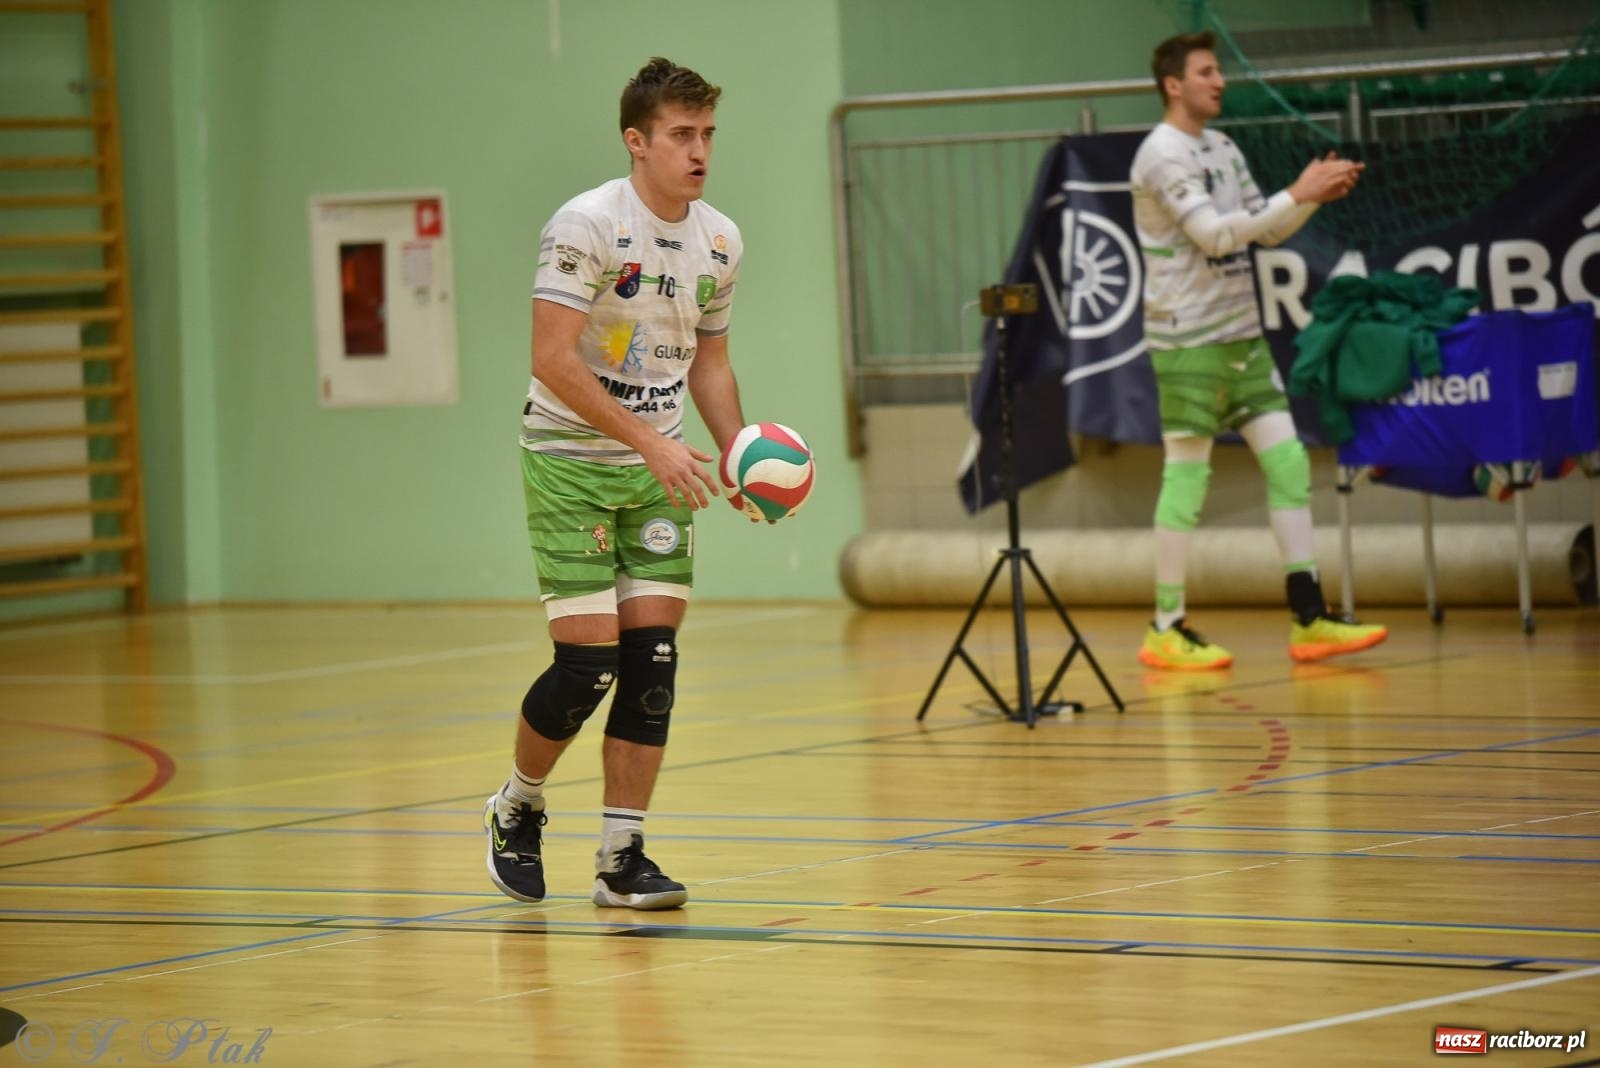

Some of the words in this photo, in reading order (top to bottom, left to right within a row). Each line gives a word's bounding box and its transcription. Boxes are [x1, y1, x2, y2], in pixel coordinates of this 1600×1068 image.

[657, 274, 675, 298] 10
[592, 372, 645, 400] OMPY
[1388, 371, 1490, 408] olten
